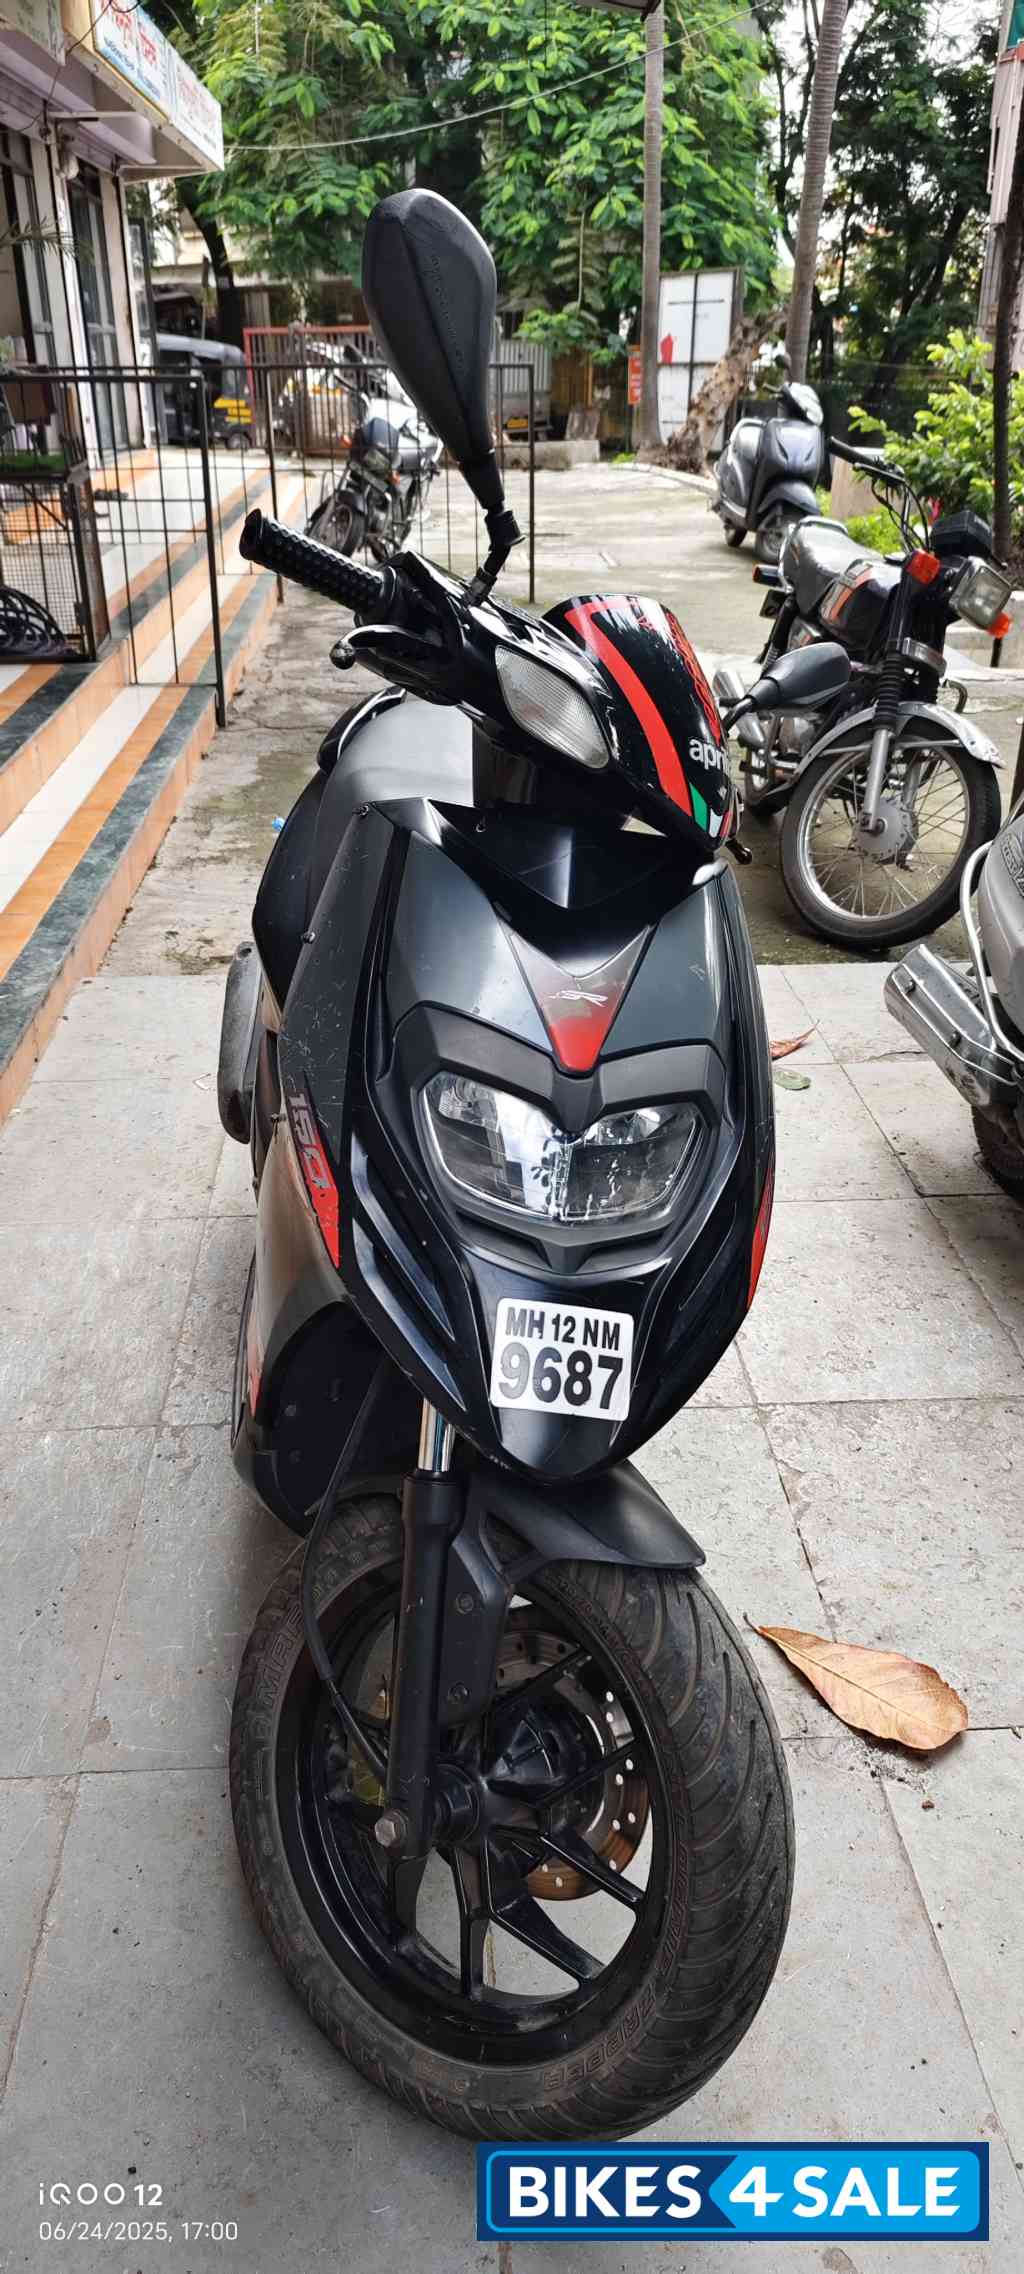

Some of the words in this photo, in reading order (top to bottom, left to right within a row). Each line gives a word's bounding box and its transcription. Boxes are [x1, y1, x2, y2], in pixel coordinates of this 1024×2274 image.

[505, 1306, 545, 1340] MH
[551, 1313, 577, 1344] 12
[582, 1318, 620, 1351] NM
[498, 1342, 624, 1410] 9687
